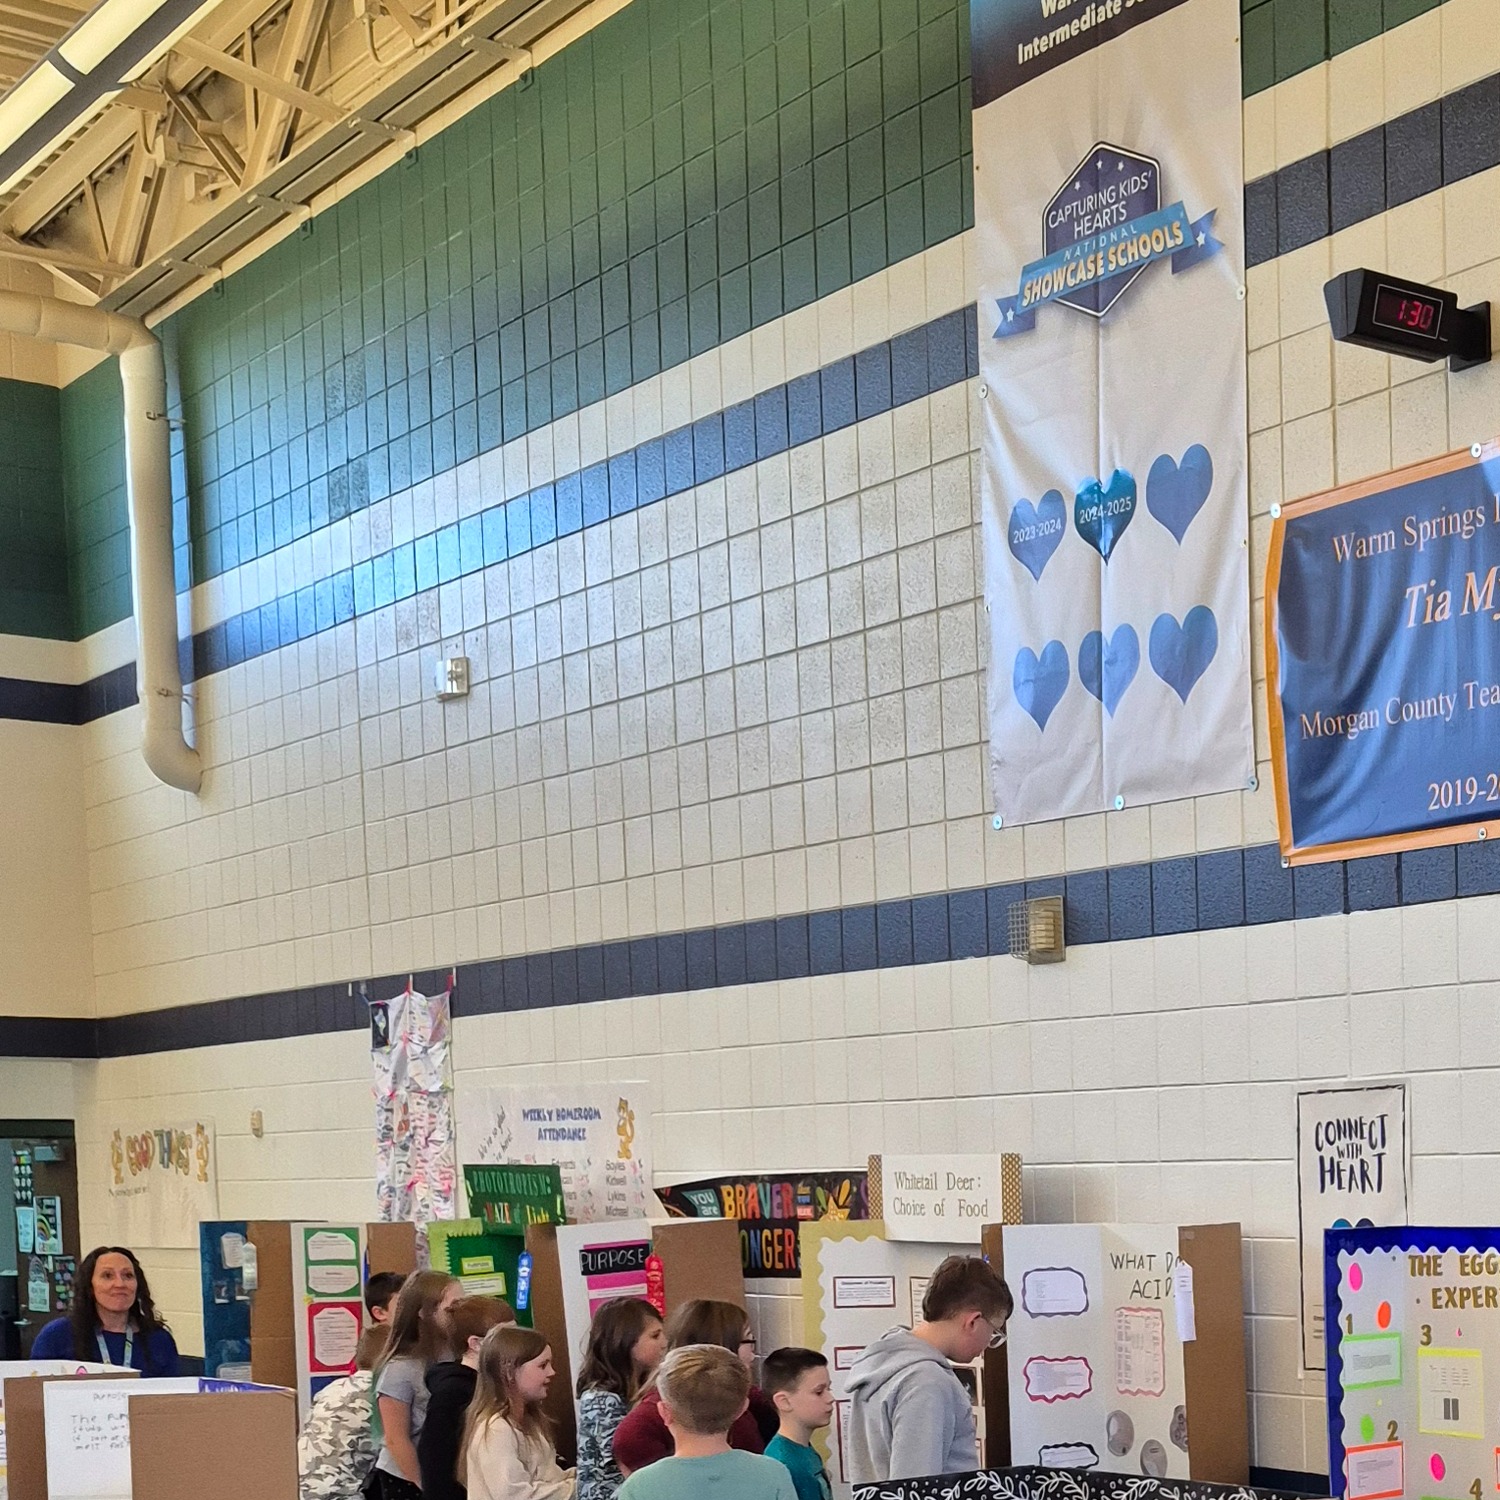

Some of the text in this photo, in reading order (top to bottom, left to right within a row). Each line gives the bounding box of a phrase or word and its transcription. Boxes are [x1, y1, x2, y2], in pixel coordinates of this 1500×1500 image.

[1018, 1, 1122, 65] Intermediate
[1048, 170, 1152, 228] CAPTURING KIDS'
[1074, 201, 1128, 240] HEARTS
[1063, 225, 1138, 262] NATIONAL
[1021, 220, 1185, 308] SHOWCASE SCHOOLS
[1332, 531, 1396, 565] Warm
[1404, 501, 1486, 554] Springs
[1404, 579, 1452, 629] Tia
[1300, 708, 1380, 742] Morgan
[1385, 686, 1458, 728] County
[522, 1107, 602, 1122] WEEKLY HOMEROOM
[537, 1127, 587, 1142] ATTENDANCE
[1314, 1113, 1388, 1153] CONNECT
[1337, 1143, 1363, 1159] WITH
[893, 1171, 981, 1192] Whitetail Deer:
[1318, 1151, 1387, 1195] HEART
[690, 1191, 715, 1205] YOU
[720, 1182, 794, 1220] BRAVER
[892, 1198, 989, 1218] Choice of Food
[701, 1205, 718, 1216] are
[580, 1248, 645, 1272] PURPOSE
[740, 1228, 796, 1269] ONGER
[1110, 1252, 1156, 1271] WHAT
[1408, 1254, 1443, 1277] THE
[1345, 1313, 1353, 1335] 1
[1420, 1324, 1432, 1346] 3
[1387, 1420, 1398, 1441] 2
[1469, 1478, 1483, 1500] 4
